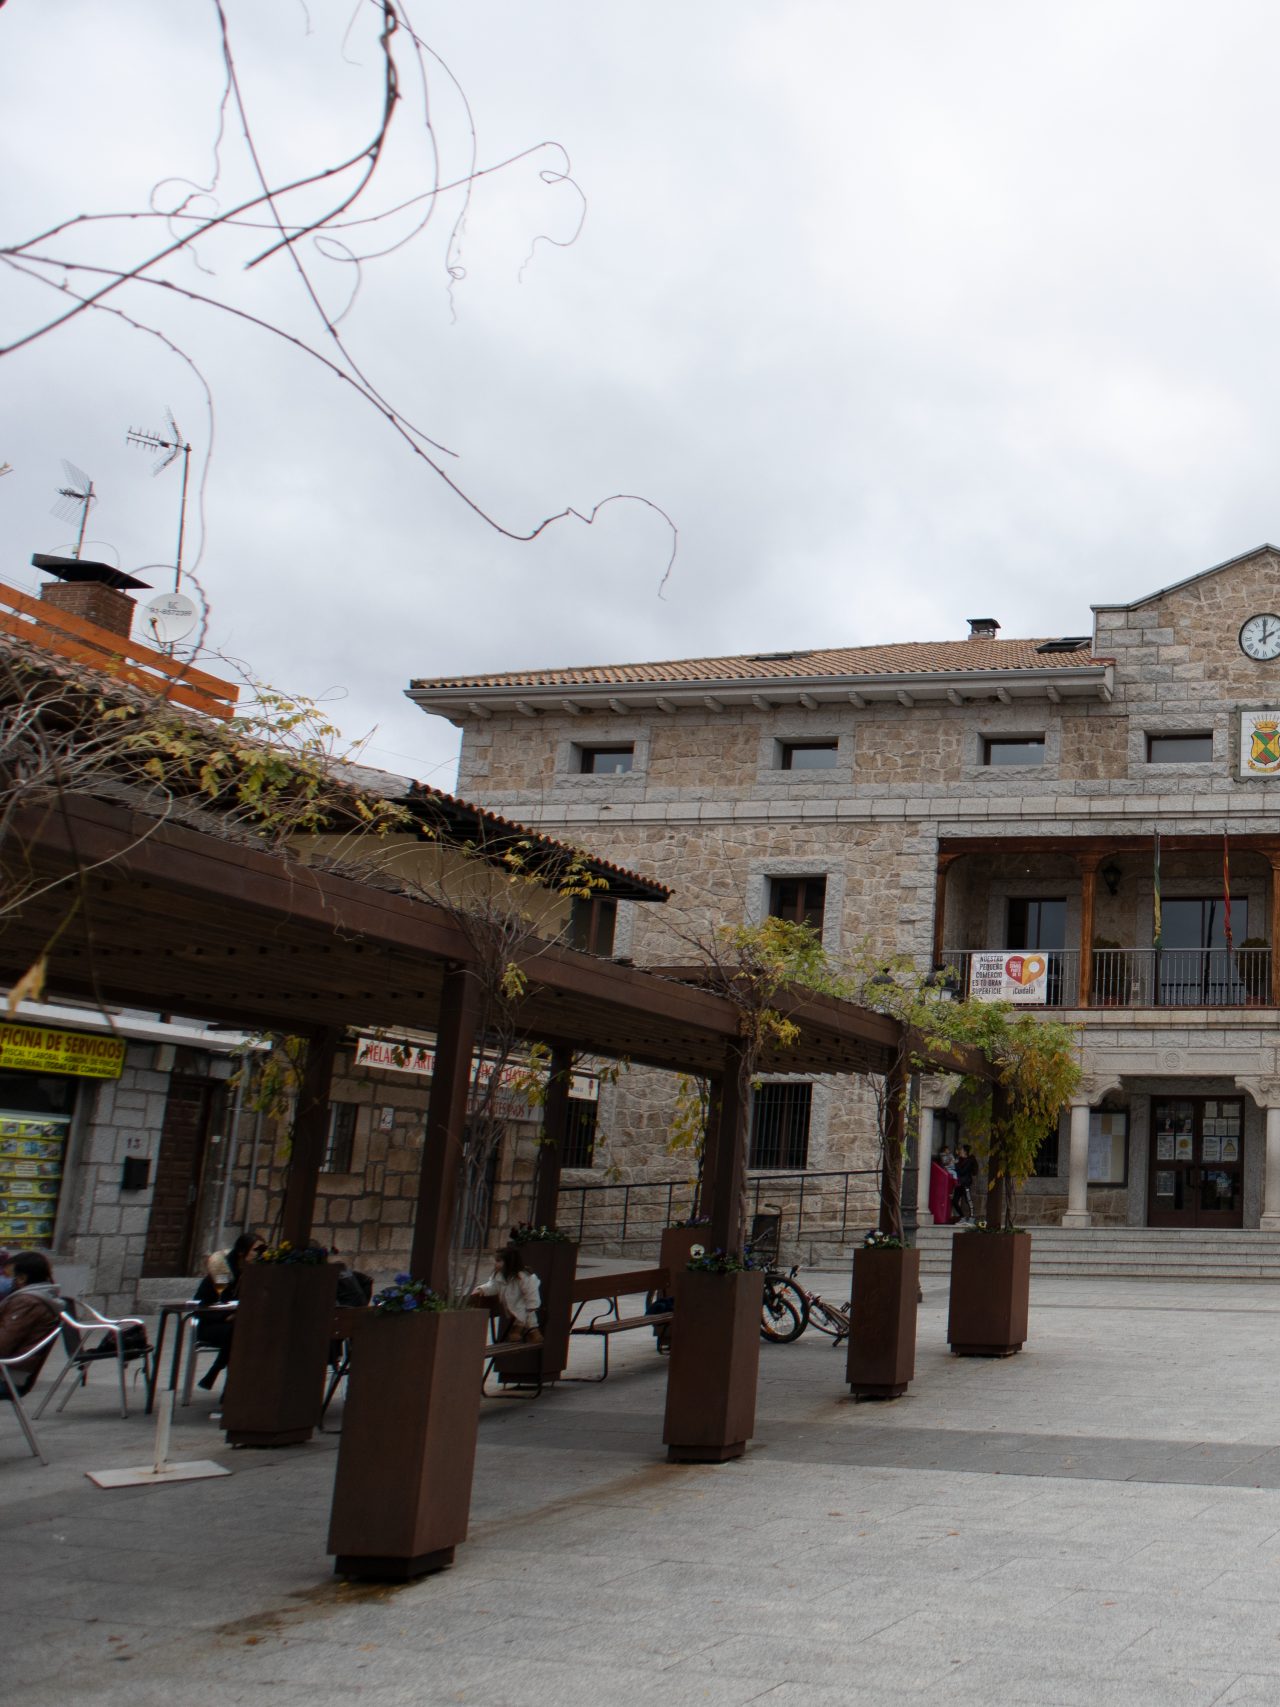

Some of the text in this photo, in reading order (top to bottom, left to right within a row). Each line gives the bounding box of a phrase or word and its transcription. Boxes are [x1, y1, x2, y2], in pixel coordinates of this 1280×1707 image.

[980, 963, 1004, 971] PEQUEÑO
[976, 971, 1003, 979] COMERCIO
[972, 987, 1002, 995] SUPERFICIE
[0, 1027, 123, 1060] FICINA DE SERVICIOS
